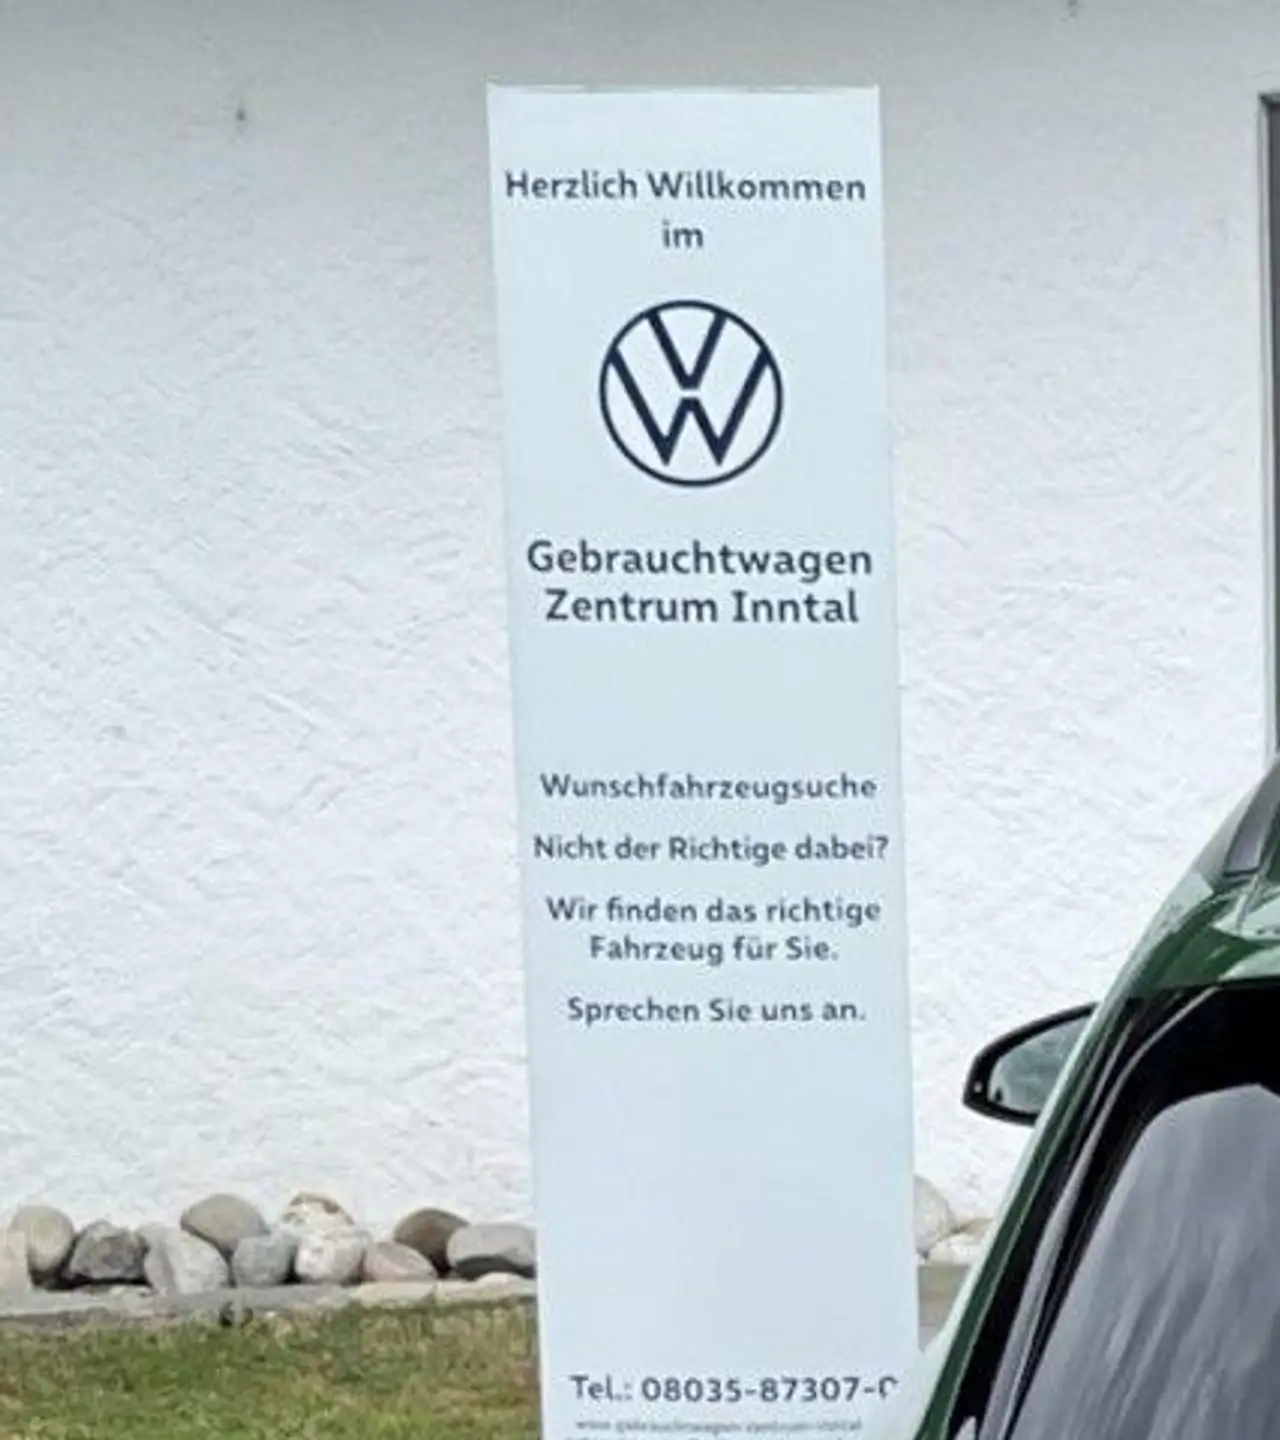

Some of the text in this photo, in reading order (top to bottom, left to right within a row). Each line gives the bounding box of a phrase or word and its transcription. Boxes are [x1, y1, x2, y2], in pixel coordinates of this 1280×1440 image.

[505, 169, 866, 201] Herzlich Willkommen
[662, 221, 704, 248] im
[527, 539, 872, 583] Gebrauchtwagen
[545, 587, 859, 623] Zentrum Inntal
[539, 772, 878, 806] Wunschfahrzeugsuche
[533, 833, 889, 868] Nicht der Richtige dabei?
[545, 895, 881, 928] Wir finden das richtige
[589, 934, 837, 967] Fahrzeug für Sie.
[567, 995, 865, 1027] Sprechen Sie uns an.
[569, 1374, 632, 1401] Tel.:
